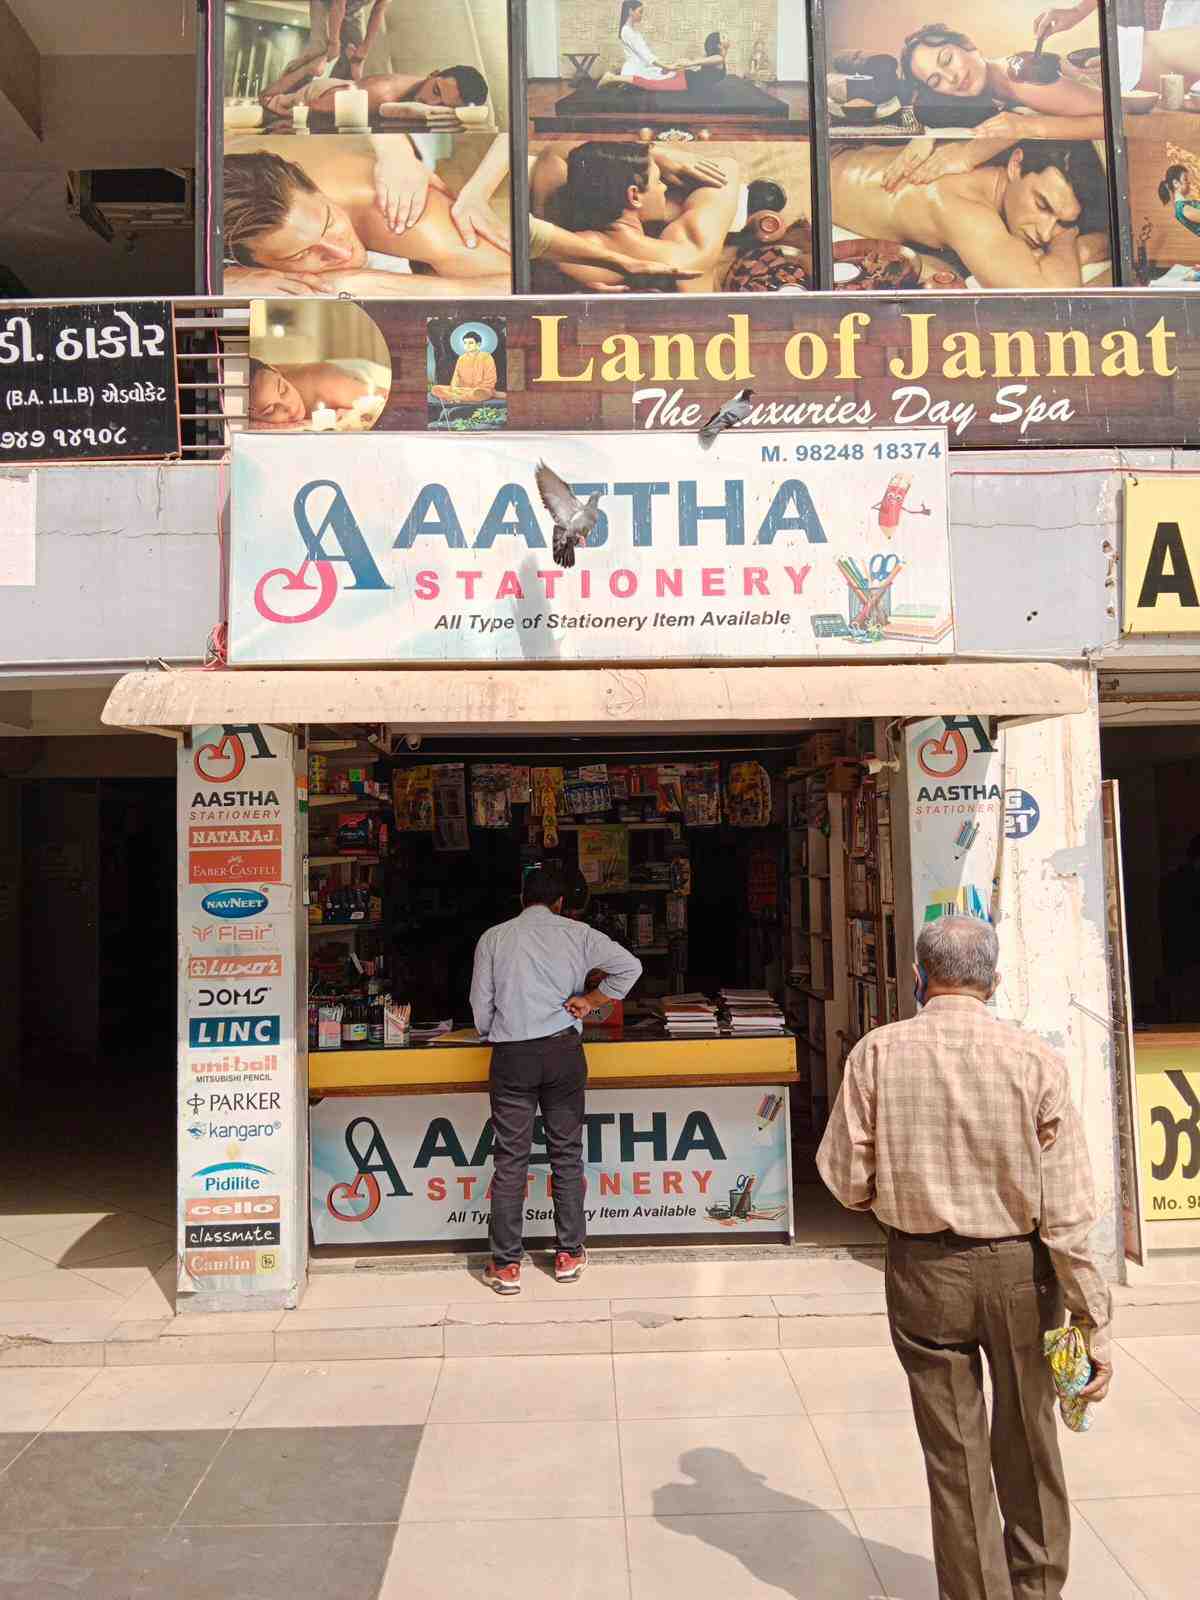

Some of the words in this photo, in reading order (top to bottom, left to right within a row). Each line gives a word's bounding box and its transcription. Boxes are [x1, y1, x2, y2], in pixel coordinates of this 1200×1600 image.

[56, 310, 165, 361] ઠાકોર
[531, 314, 756, 382] Land
[784, 312, 871, 380] of
[889, 313, 1179, 380] Jannat
[632, 388, 702, 429] The
[733, 390, 877, 427] uxuries
[892, 386, 977, 436] Day
[990, 385, 1075, 434] Spa
[53, 427, 127, 447] ૧૪૧૦૮
[761, 446, 788, 462] M.
[796, 444, 864, 461] 98248
[873, 442, 943, 459] 18374
[415, 563, 812, 600] STATIONERY
[435, 615, 463, 630] All
[469, 614, 514, 632] Type
[522, 614, 543, 629] of
[547, 613, 648, 632] Stationery
[653, 612, 695, 627] Item
[700, 610, 792, 626] Available
[192, 790, 280, 807] AASTHA
[917, 784, 1002, 803] AASTHA
[189, 809, 281, 821] STATIONERY
[192, 829, 275, 844] NATARAJ
[219, 926, 272, 941] Flair
[199, 987, 268, 1006] DOMS
[198, 1020, 272, 1042] LINC
[196, 1073, 241, 1083] MITSUBISHI
[243, 1072, 273, 1082] PENCIL
[210, 1092, 281, 1110] PARKER
[205, 1177, 261, 1191] Pidilite
[190, 1202, 275, 1215] cello
[1153, 1196, 1182, 1210] Mo.
[447, 1211, 466, 1222] All
[600, 1206, 629, 1218] Item
[633, 1204, 697, 1217] Available
[191, 1226, 275, 1243] classmate
